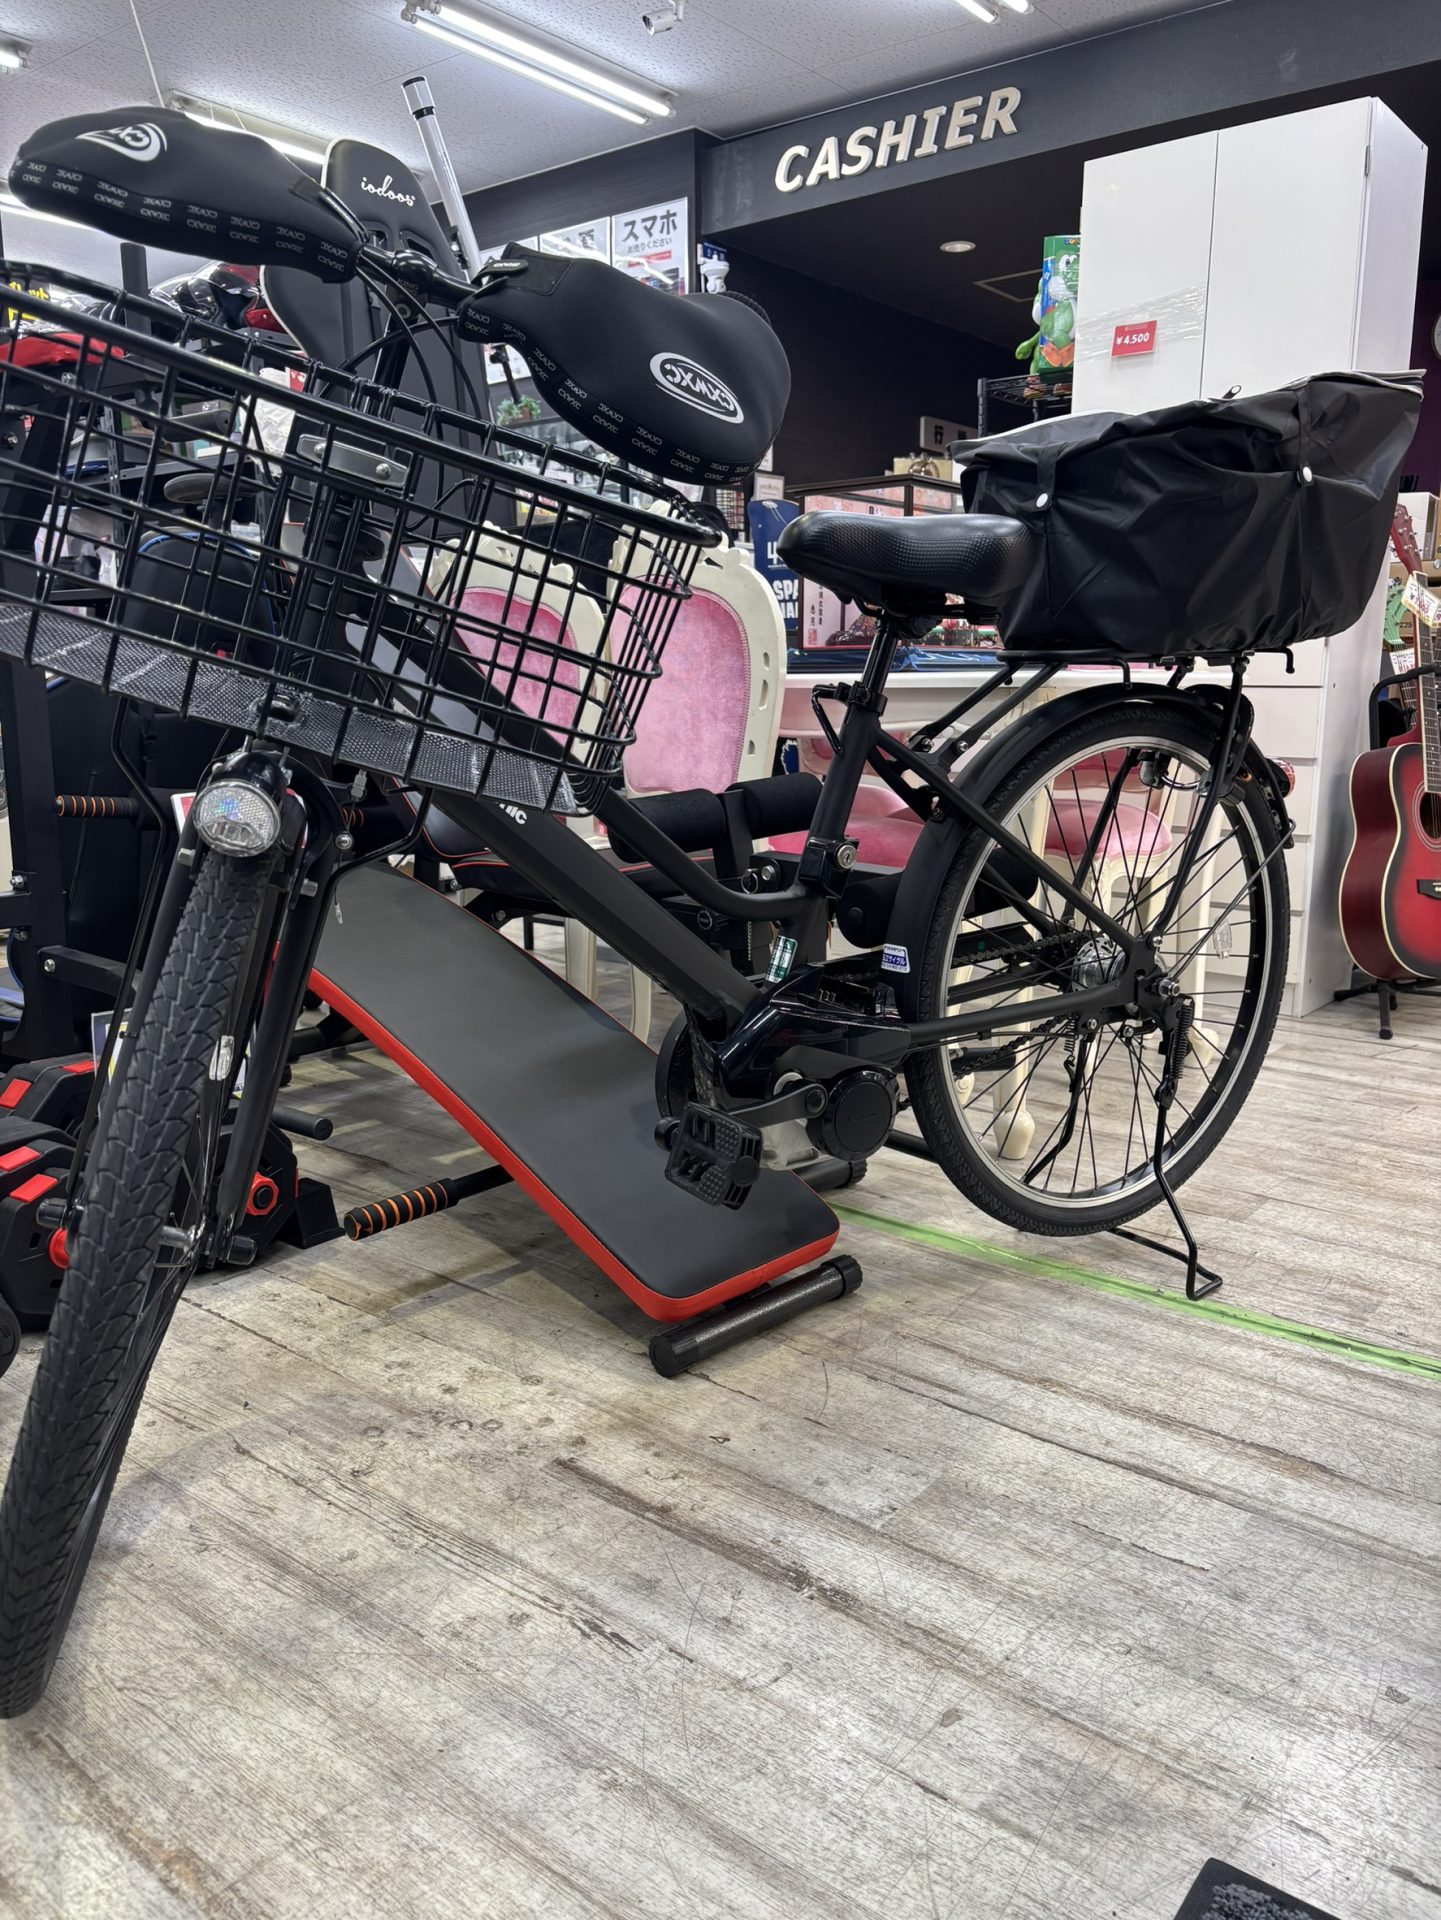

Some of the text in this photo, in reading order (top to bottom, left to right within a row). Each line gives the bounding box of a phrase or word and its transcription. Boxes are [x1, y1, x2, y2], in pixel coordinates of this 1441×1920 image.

[774, 85, 1022, 193] CASHIER
[622, 209, 678, 242] スマホ
